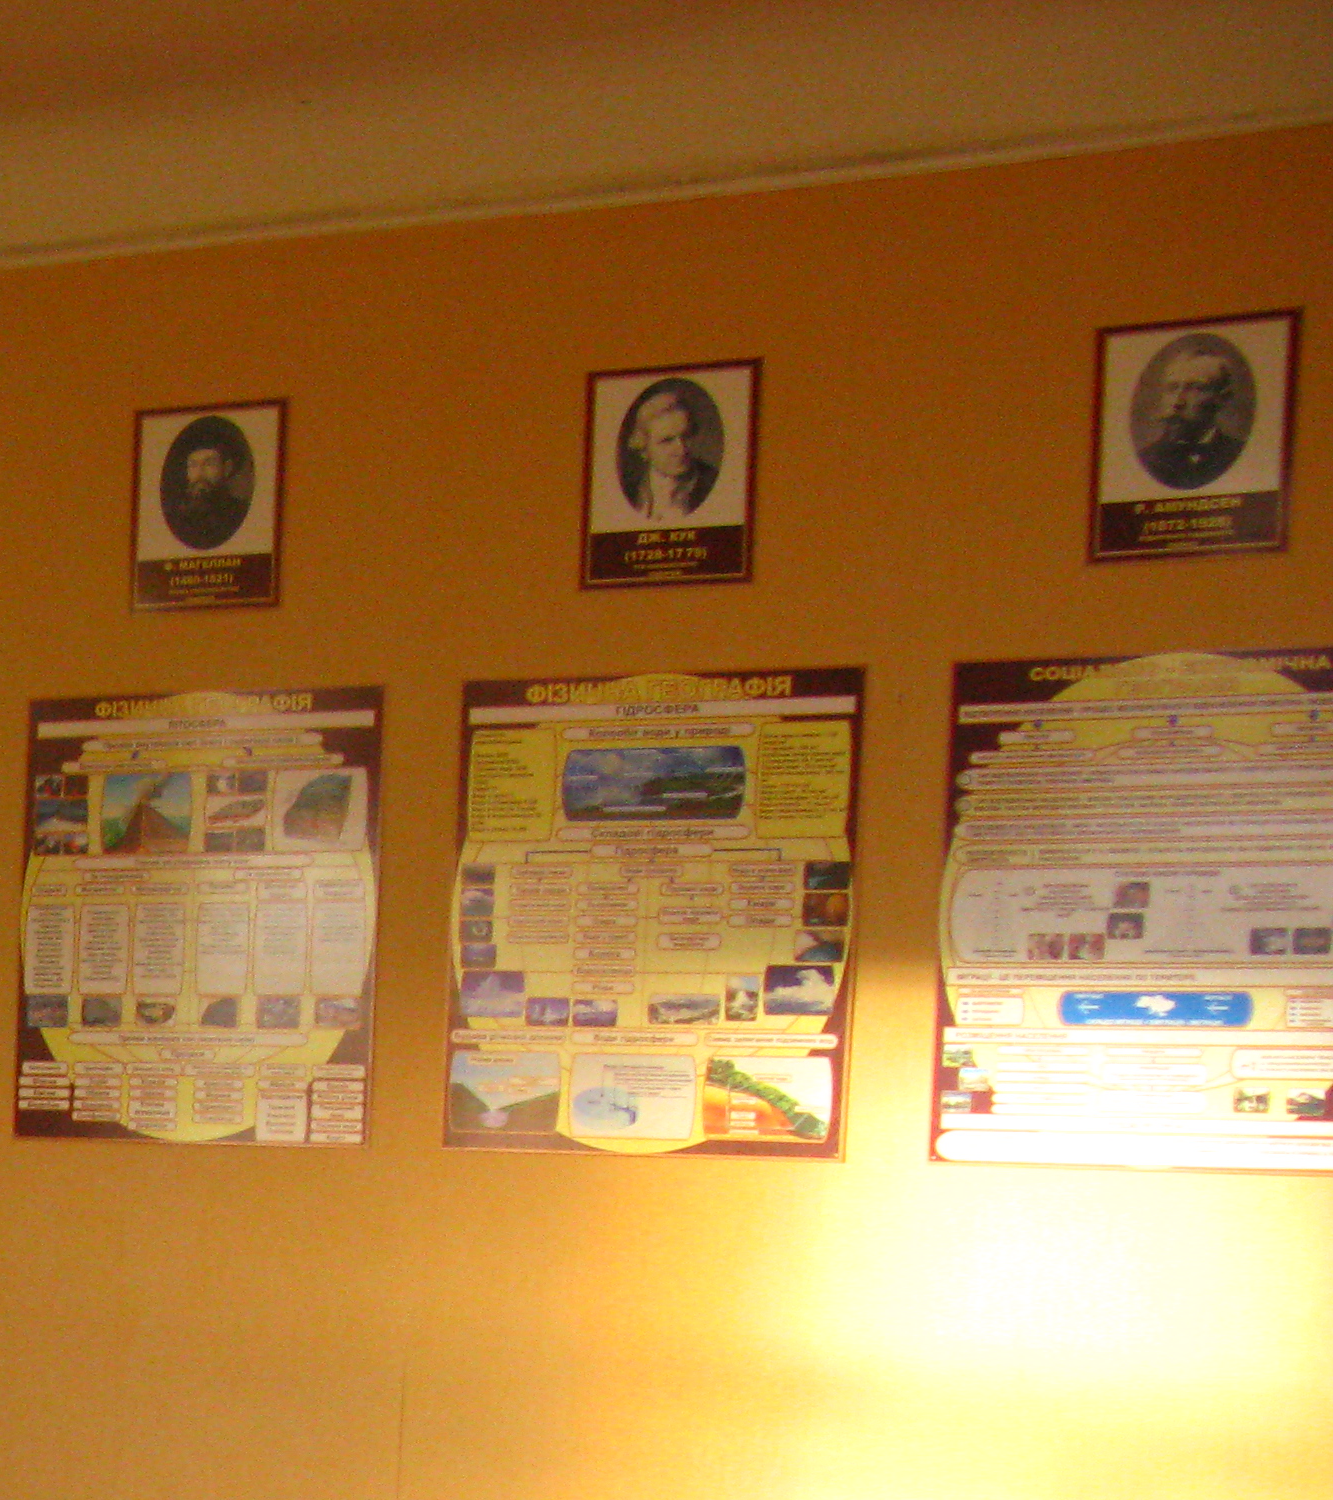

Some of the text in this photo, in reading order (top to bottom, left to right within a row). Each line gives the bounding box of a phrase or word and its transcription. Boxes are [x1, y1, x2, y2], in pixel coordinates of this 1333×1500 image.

[94, 693, 314, 718] ФІЗИЧ РАФІЯ
[614, 703, 701, 718] ГІДРОСФЕРА
